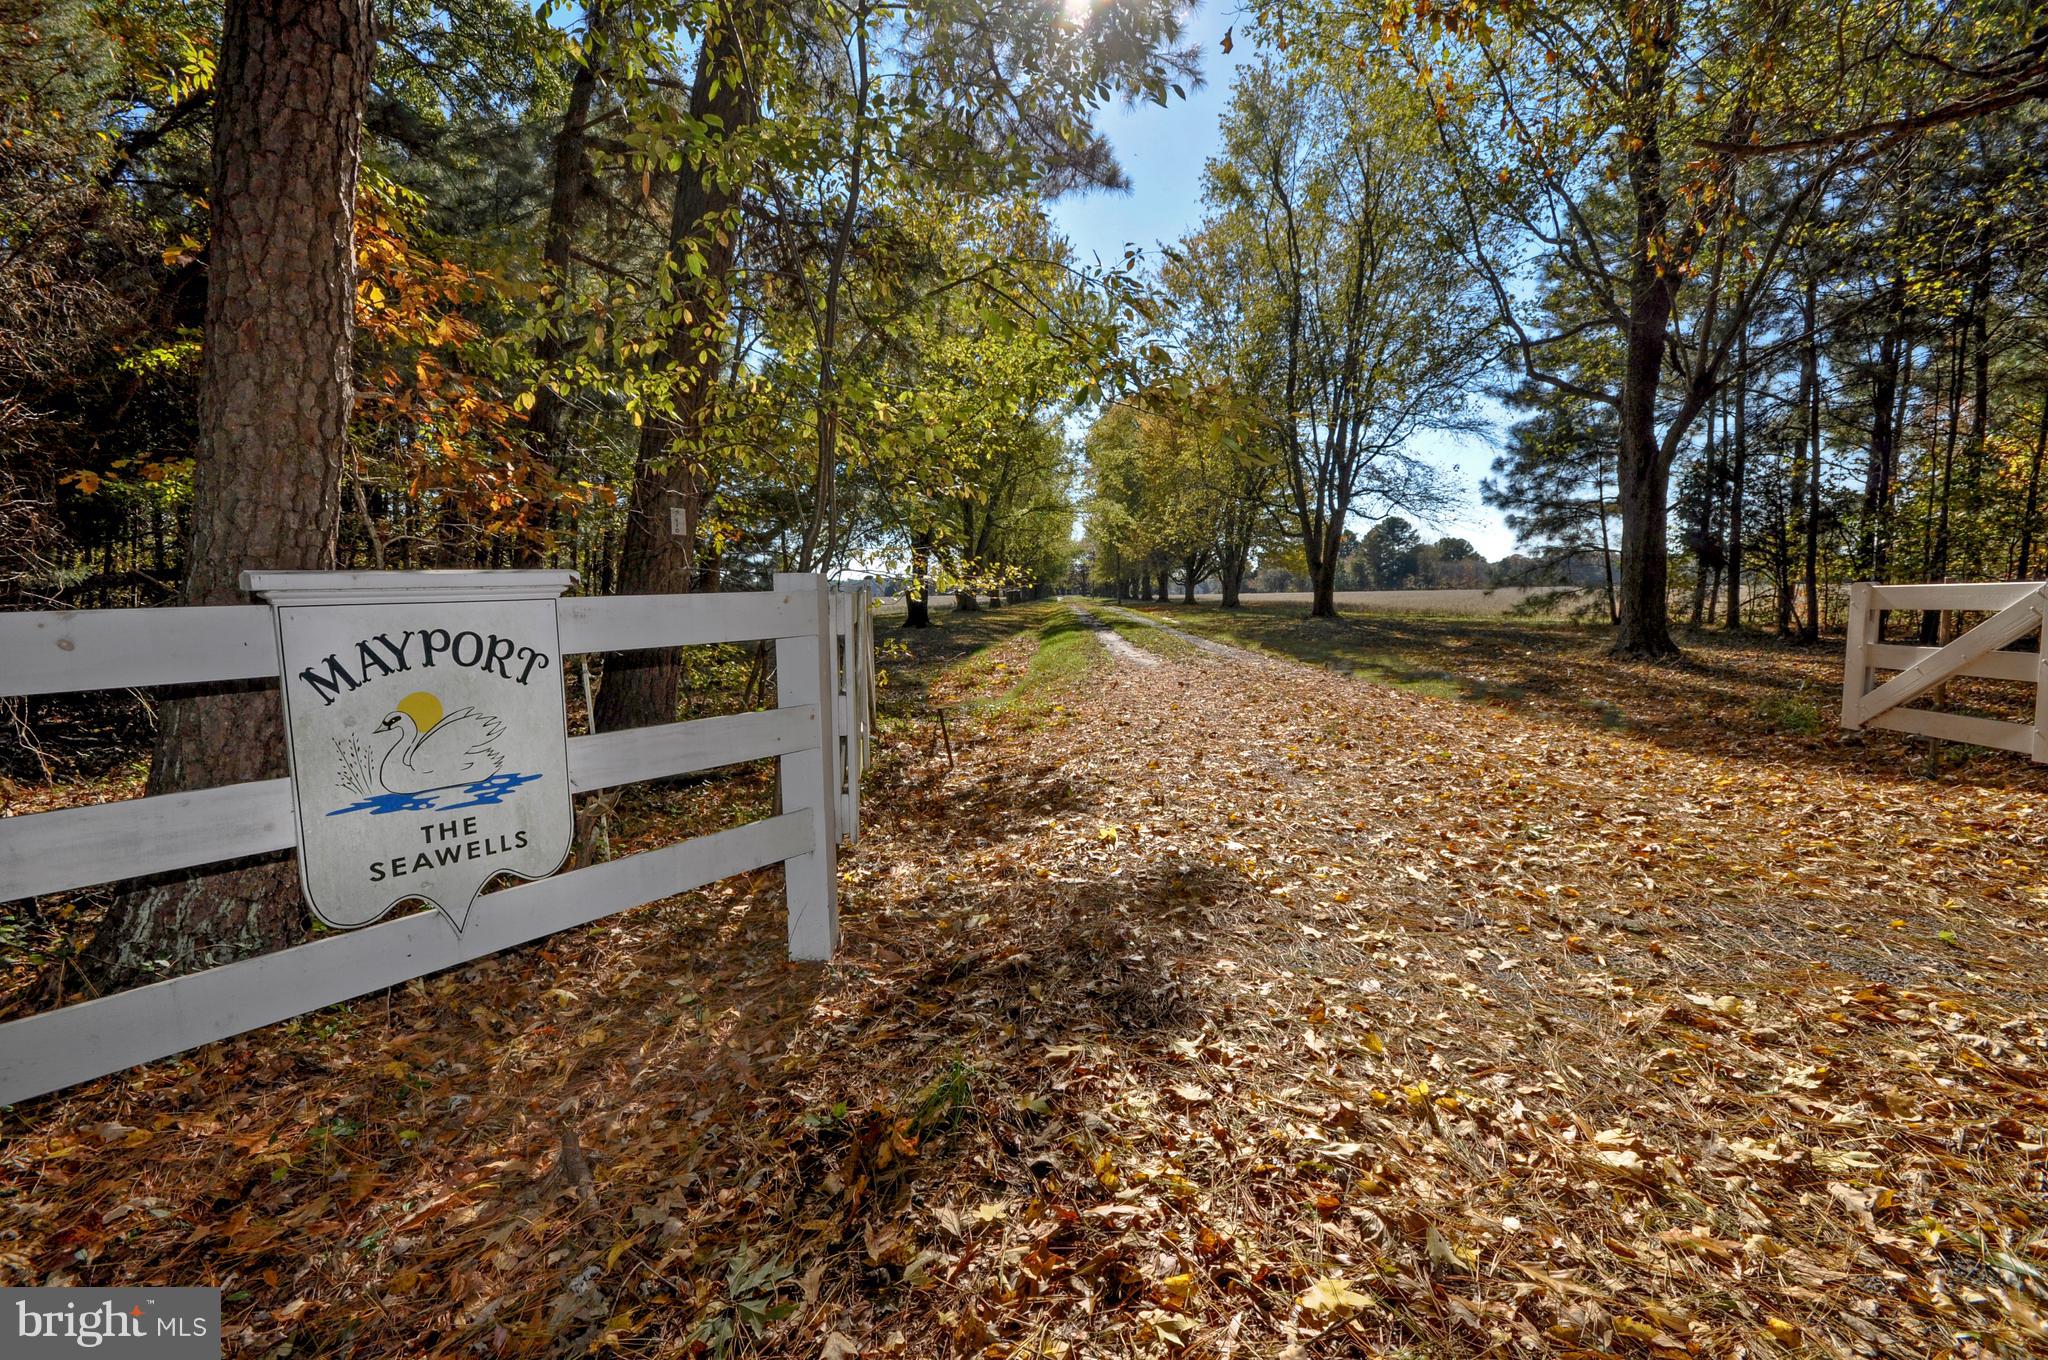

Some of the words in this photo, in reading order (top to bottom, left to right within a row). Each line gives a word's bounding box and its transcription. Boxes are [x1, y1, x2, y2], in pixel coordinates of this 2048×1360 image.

[299, 628, 550, 706] MAYPORT
[369, 830, 528, 882] SEAWELLS
[420, 816, 478, 844] THE
